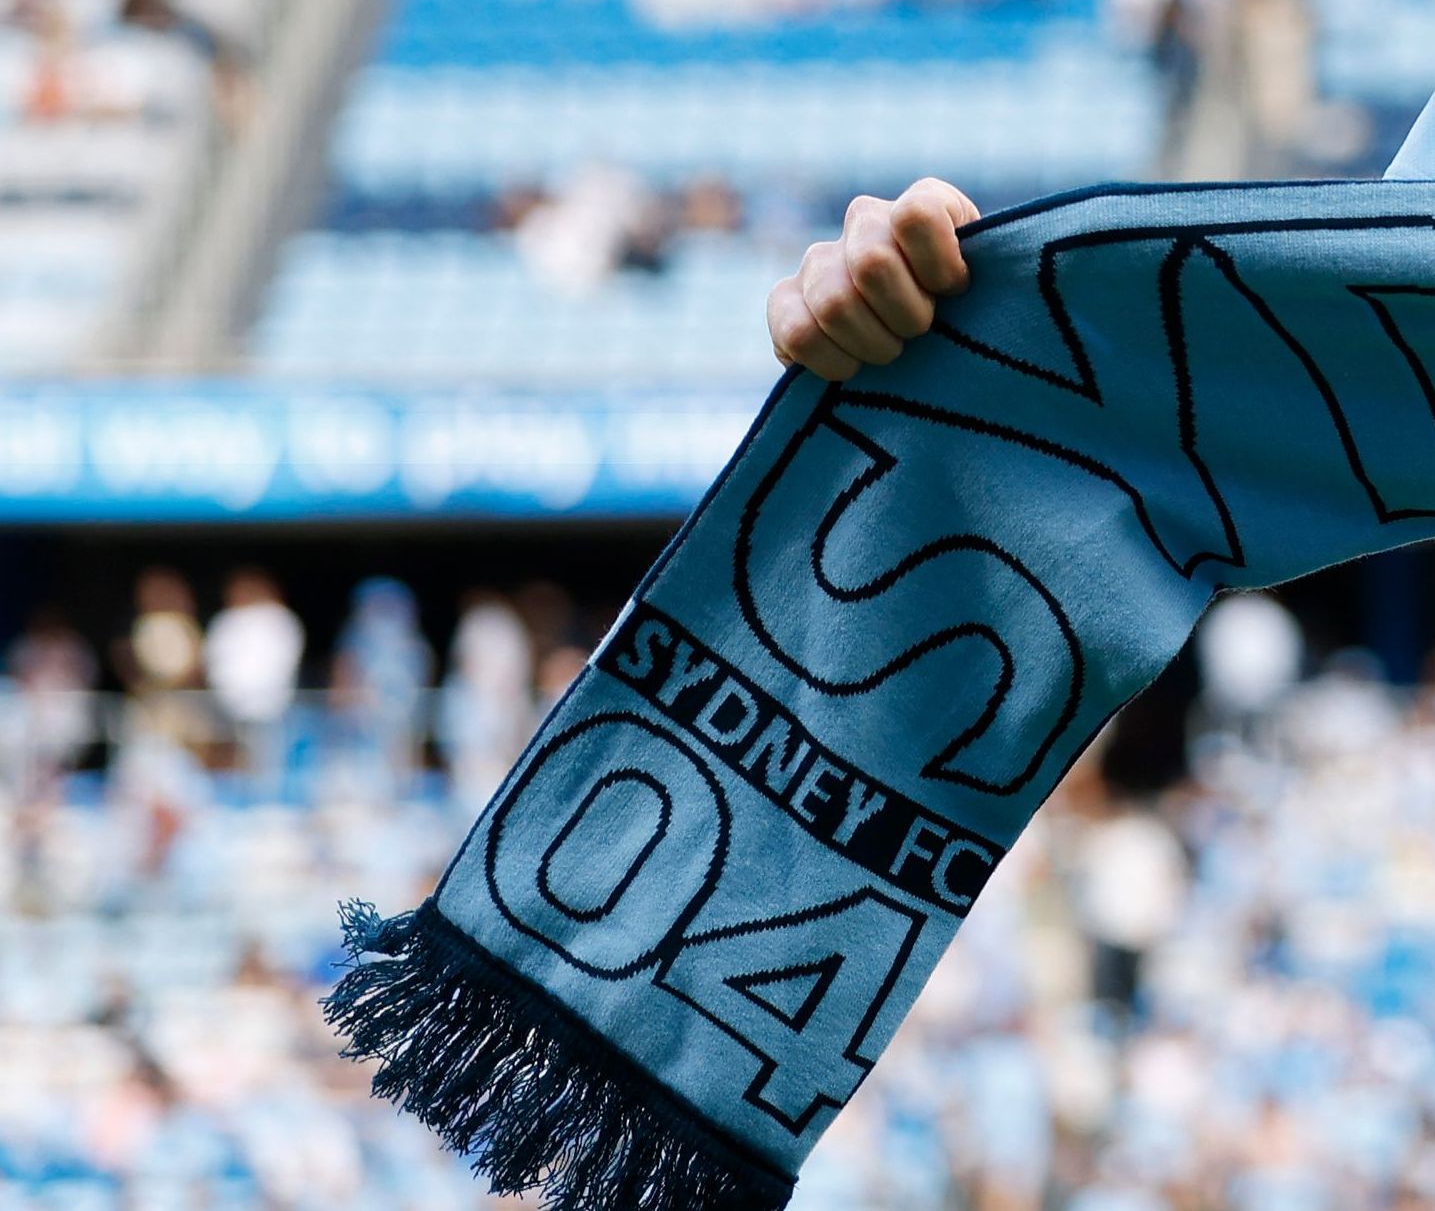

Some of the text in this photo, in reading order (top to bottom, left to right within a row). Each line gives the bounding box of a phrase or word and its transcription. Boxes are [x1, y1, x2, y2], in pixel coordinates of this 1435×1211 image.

[486, 711, 929, 1138] 04
[616, 619, 993, 907] SYDNEY FC
